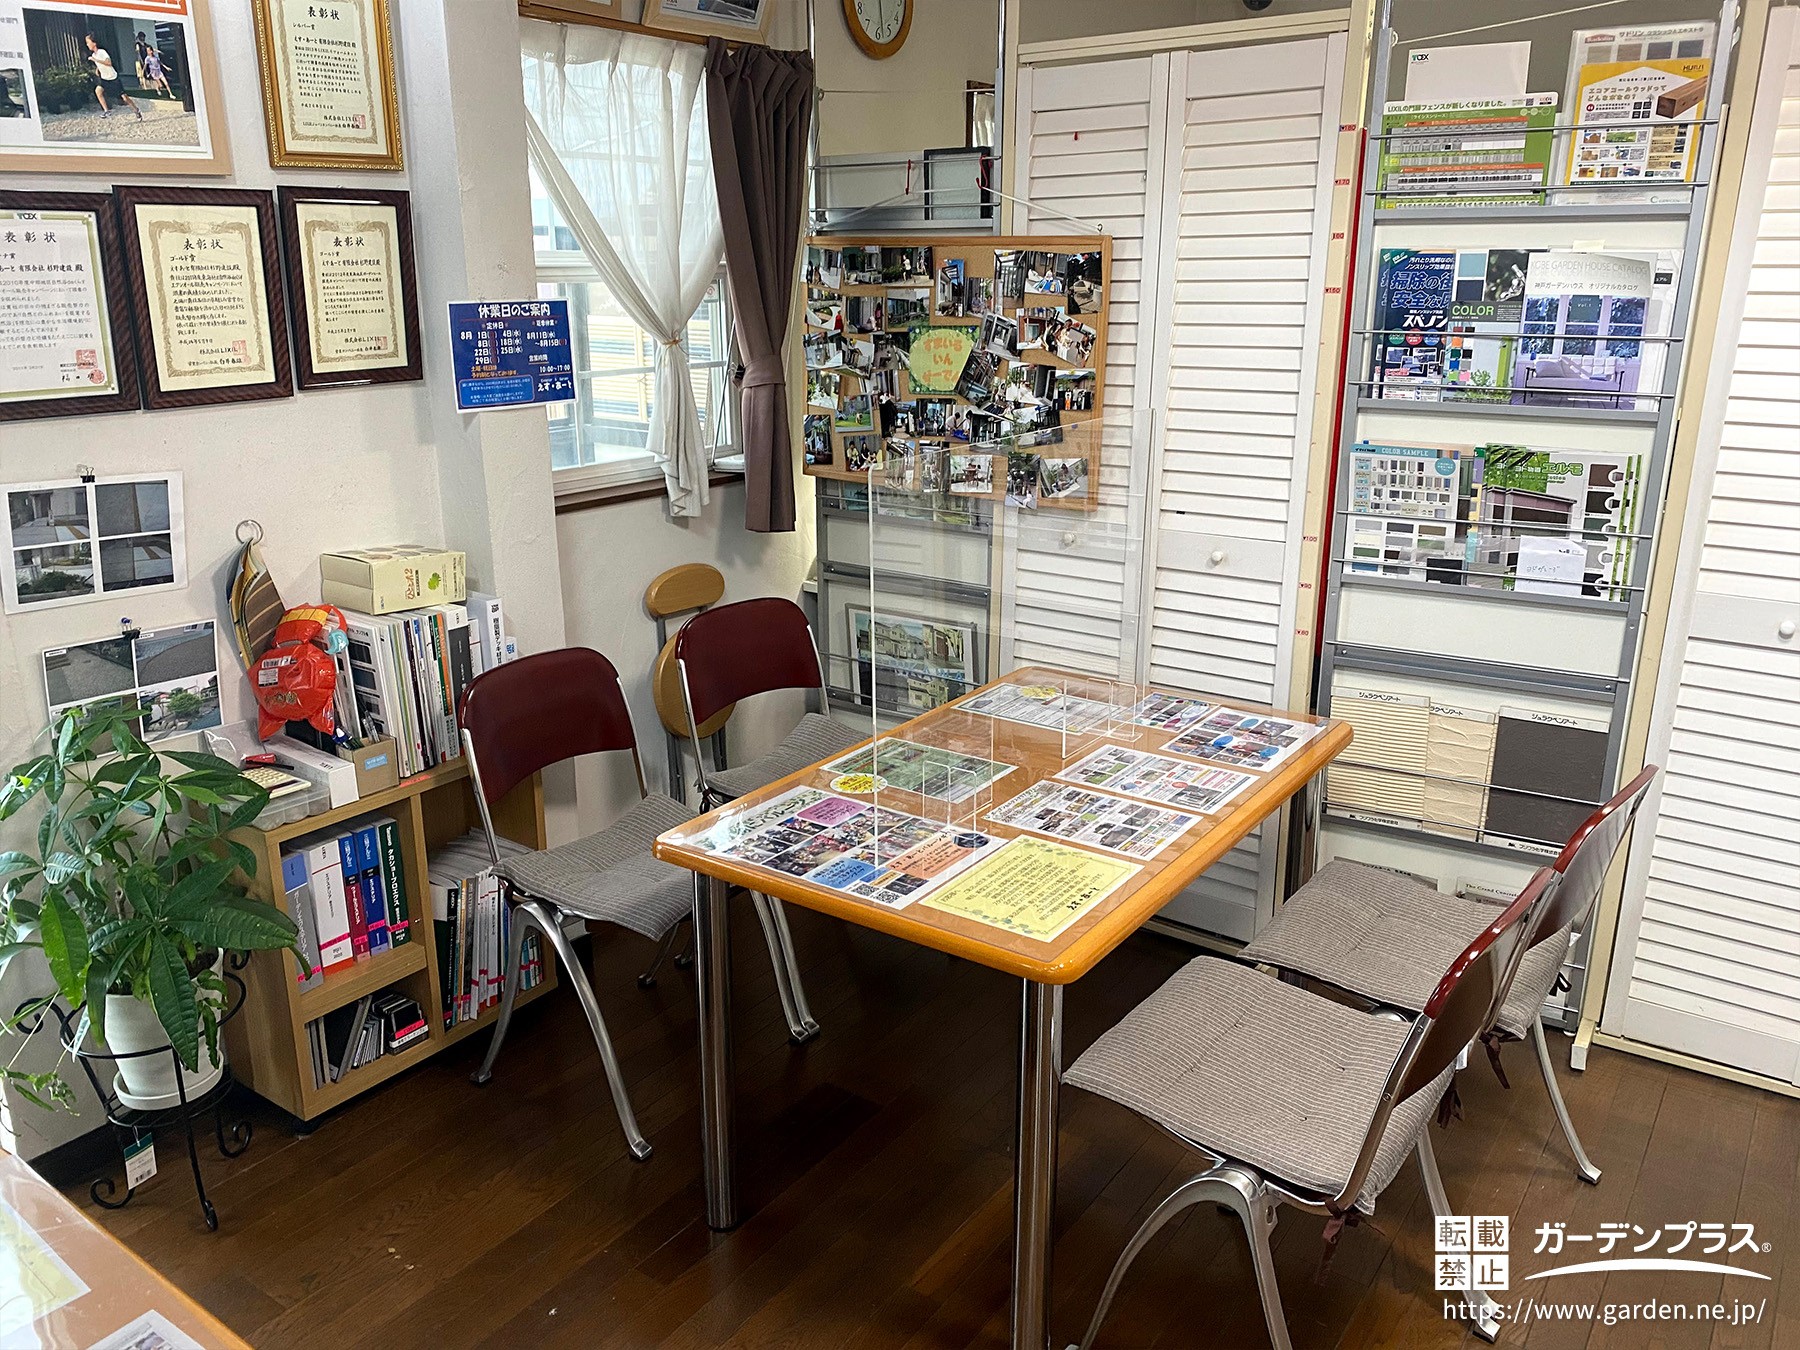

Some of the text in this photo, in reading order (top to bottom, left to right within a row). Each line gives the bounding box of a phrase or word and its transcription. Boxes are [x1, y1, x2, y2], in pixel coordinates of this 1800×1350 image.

[307, 5, 341, 21] 表彰状
[857, 1, 863, 15] 8
[864, 18, 871, 32] 7
[893, 11, 899, 25] 4
[875, 26, 881, 40] 6
[886, 23, 892, 38] 5
[4, 230, 57, 243] 表彰状
[332, 235, 365, 248] 表彰状
[183, 237, 224, 251] 表彰状
[0, 252, 16, 260] ナ賞
[1534, 281, 1639, 292] 神戸ガーデンハウス オリジナルカタログ
[477, 302, 551, 319] 休業日のご案内
[1451, 304, 1495, 316] COLOR
[486, 321, 504, 330] 定休日
[460, 331, 473, 340] 8月
[1541, 461, 1584, 477] エルモ
